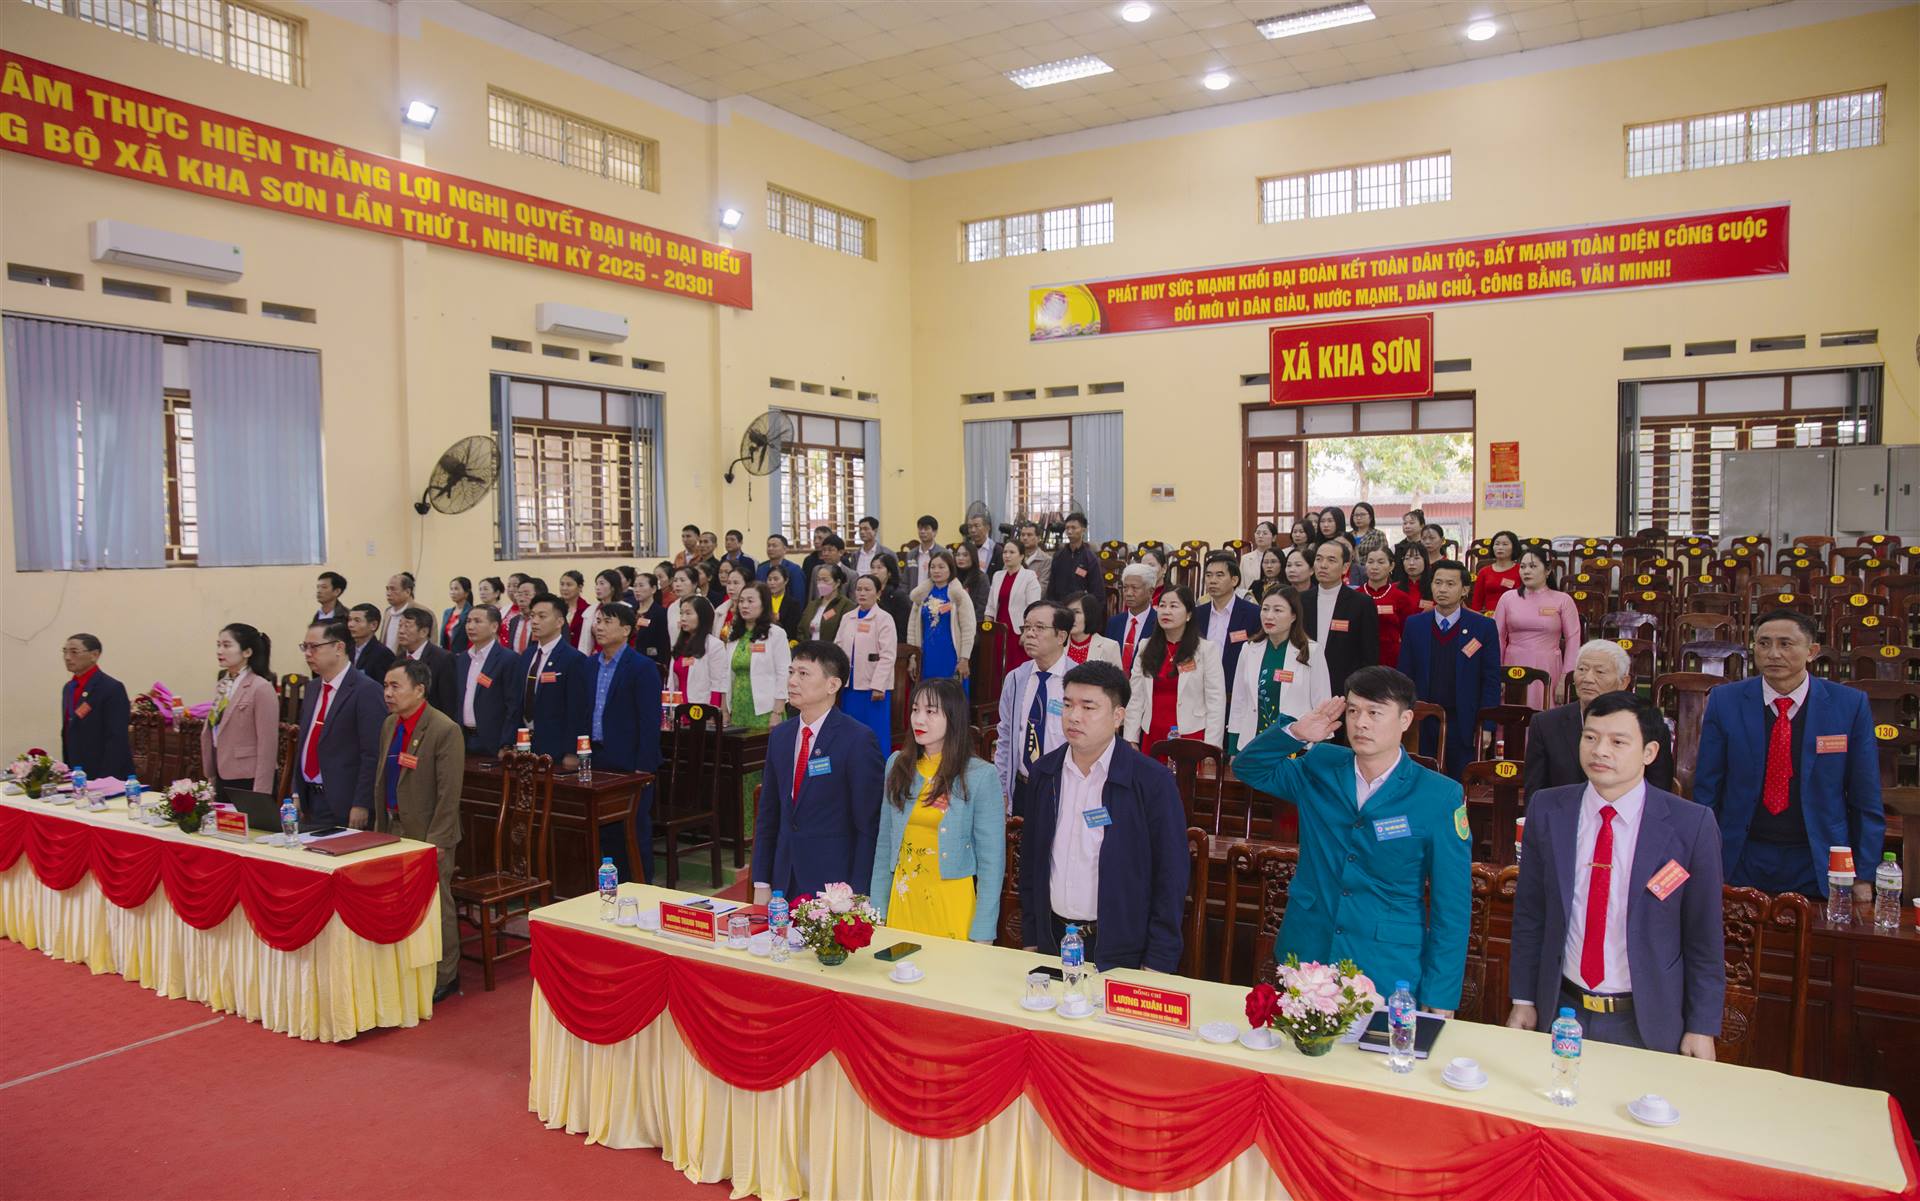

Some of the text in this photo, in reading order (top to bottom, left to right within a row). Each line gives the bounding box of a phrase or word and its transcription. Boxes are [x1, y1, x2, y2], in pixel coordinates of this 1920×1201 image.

[86, 89, 189, 141] THỰC
[200, 120, 282, 163] HIỆN
[290, 144, 392, 192] THẮNG
[399, 171, 442, 206] LỢI
[447, 184, 509, 224] NGHỊ
[515, 202, 584, 238] QUYẾT
[589, 220, 624, 249] ĐẠI
[628, 231, 662, 258] HỘI
[666, 240, 698, 267] ĐẠI
[702, 248, 742, 275] BIỂU
[43, 122, 101, 167] BỘ
[114, 140, 168, 178] XÃ
[177, 155, 251, 196] KHA
[260, 175, 328, 213] SƠN
[336, 191, 393, 228] LẦN
[400, 207, 455, 240] THỨ
[457, 221, 478, 248] I,
[482, 226, 560, 264] NHIỆM
[565, 245, 594, 270] KỲ
[598, 254, 647, 282] 2025
[663, 269, 714, 297] 2030!
[1107, 217, 1767, 304] PHÁT HUY SỨC MẠNH KHỐI ĐẠI ĐOÀN KẾT TOÀN DÂN TỘC, ĐẨY MẠNH TOÀN DIỆN CÔNG CUỘC
[1174, 259, 1673, 322] ĐỔI MỚI VÌ DÂN GIÀU, NƯỚC MẠNH, DÂN CHỦ, CÔNG BẰNG, VĂN MINH!
[1281, 336, 1421, 382] XÃ KHA SƠN
[1877, 726, 1894, 738] 130
[1500, 764, 1514, 775] 107
[1113, 994, 1139, 1007] LƯƠNG
[1140, 999, 1163, 1012] XUÂN
[1163, 1003, 1183, 1016] LINH
